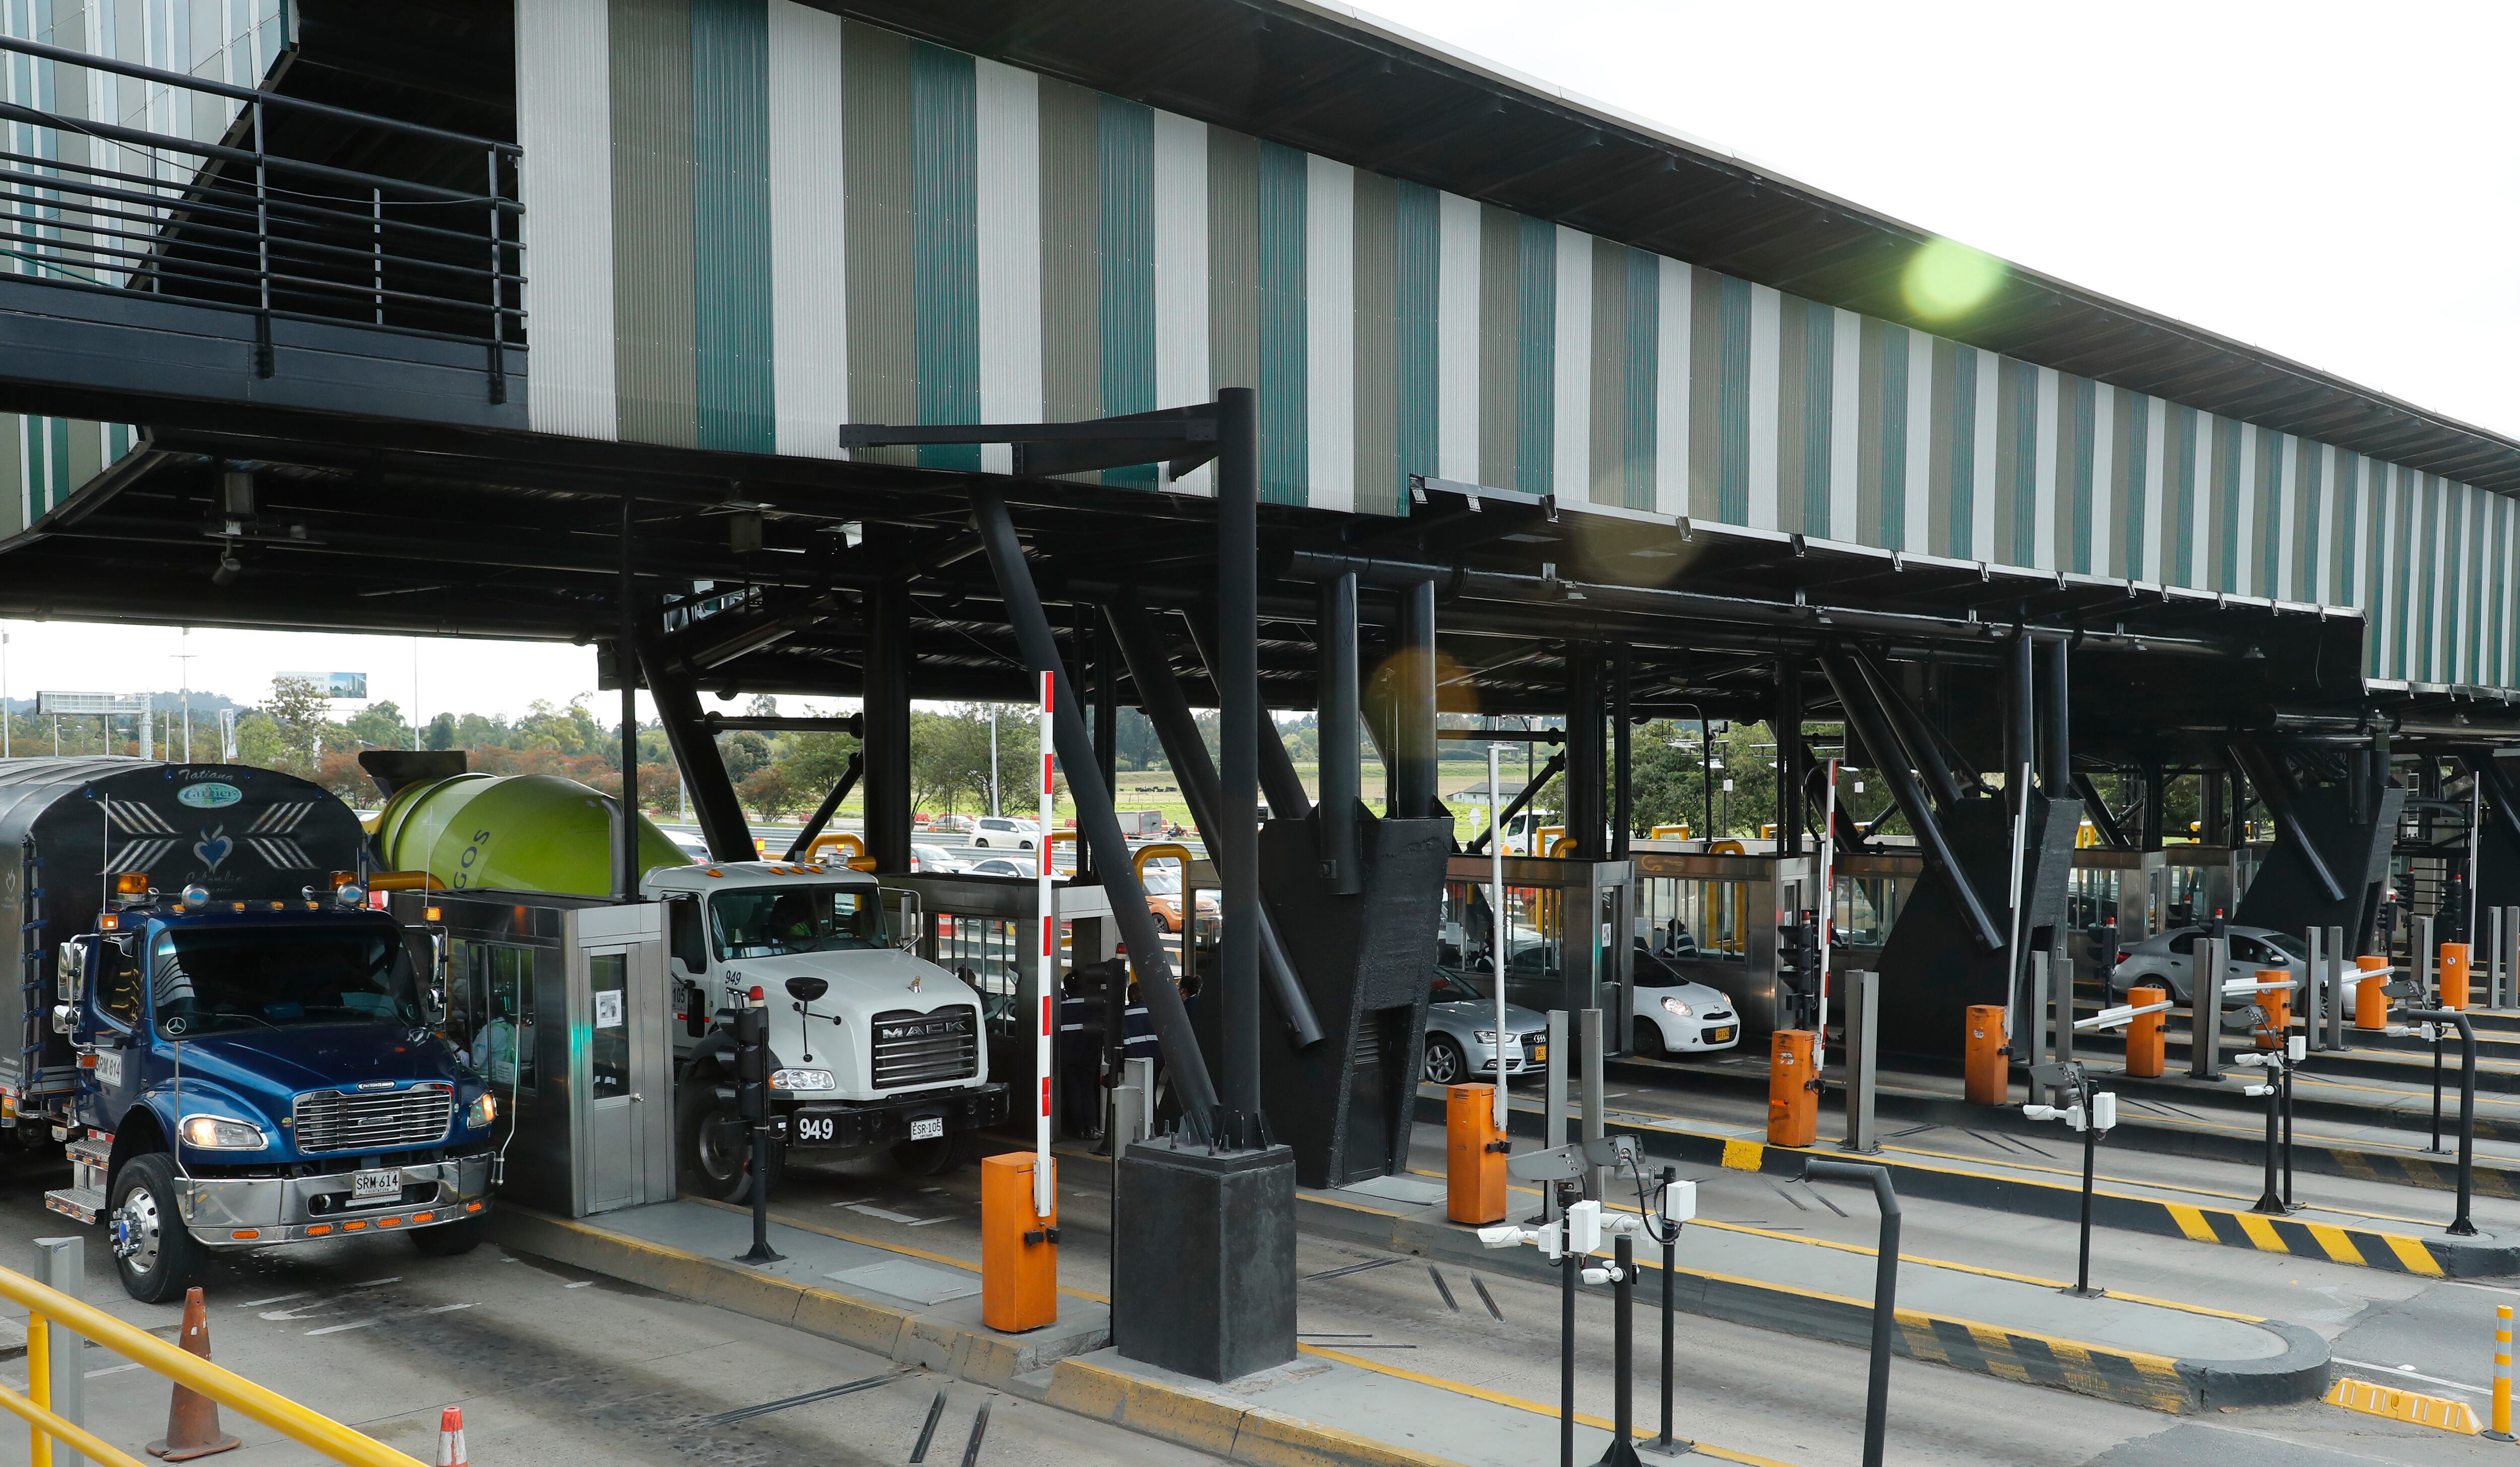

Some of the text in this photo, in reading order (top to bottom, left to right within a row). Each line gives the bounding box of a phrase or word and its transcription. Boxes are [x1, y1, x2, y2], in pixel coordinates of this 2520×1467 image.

[178, 769, 234, 781] Tatiana
[725, 970, 741, 985] 949
[883, 1020, 966, 1039] MACK
[799, 1118, 833, 1139] 949
